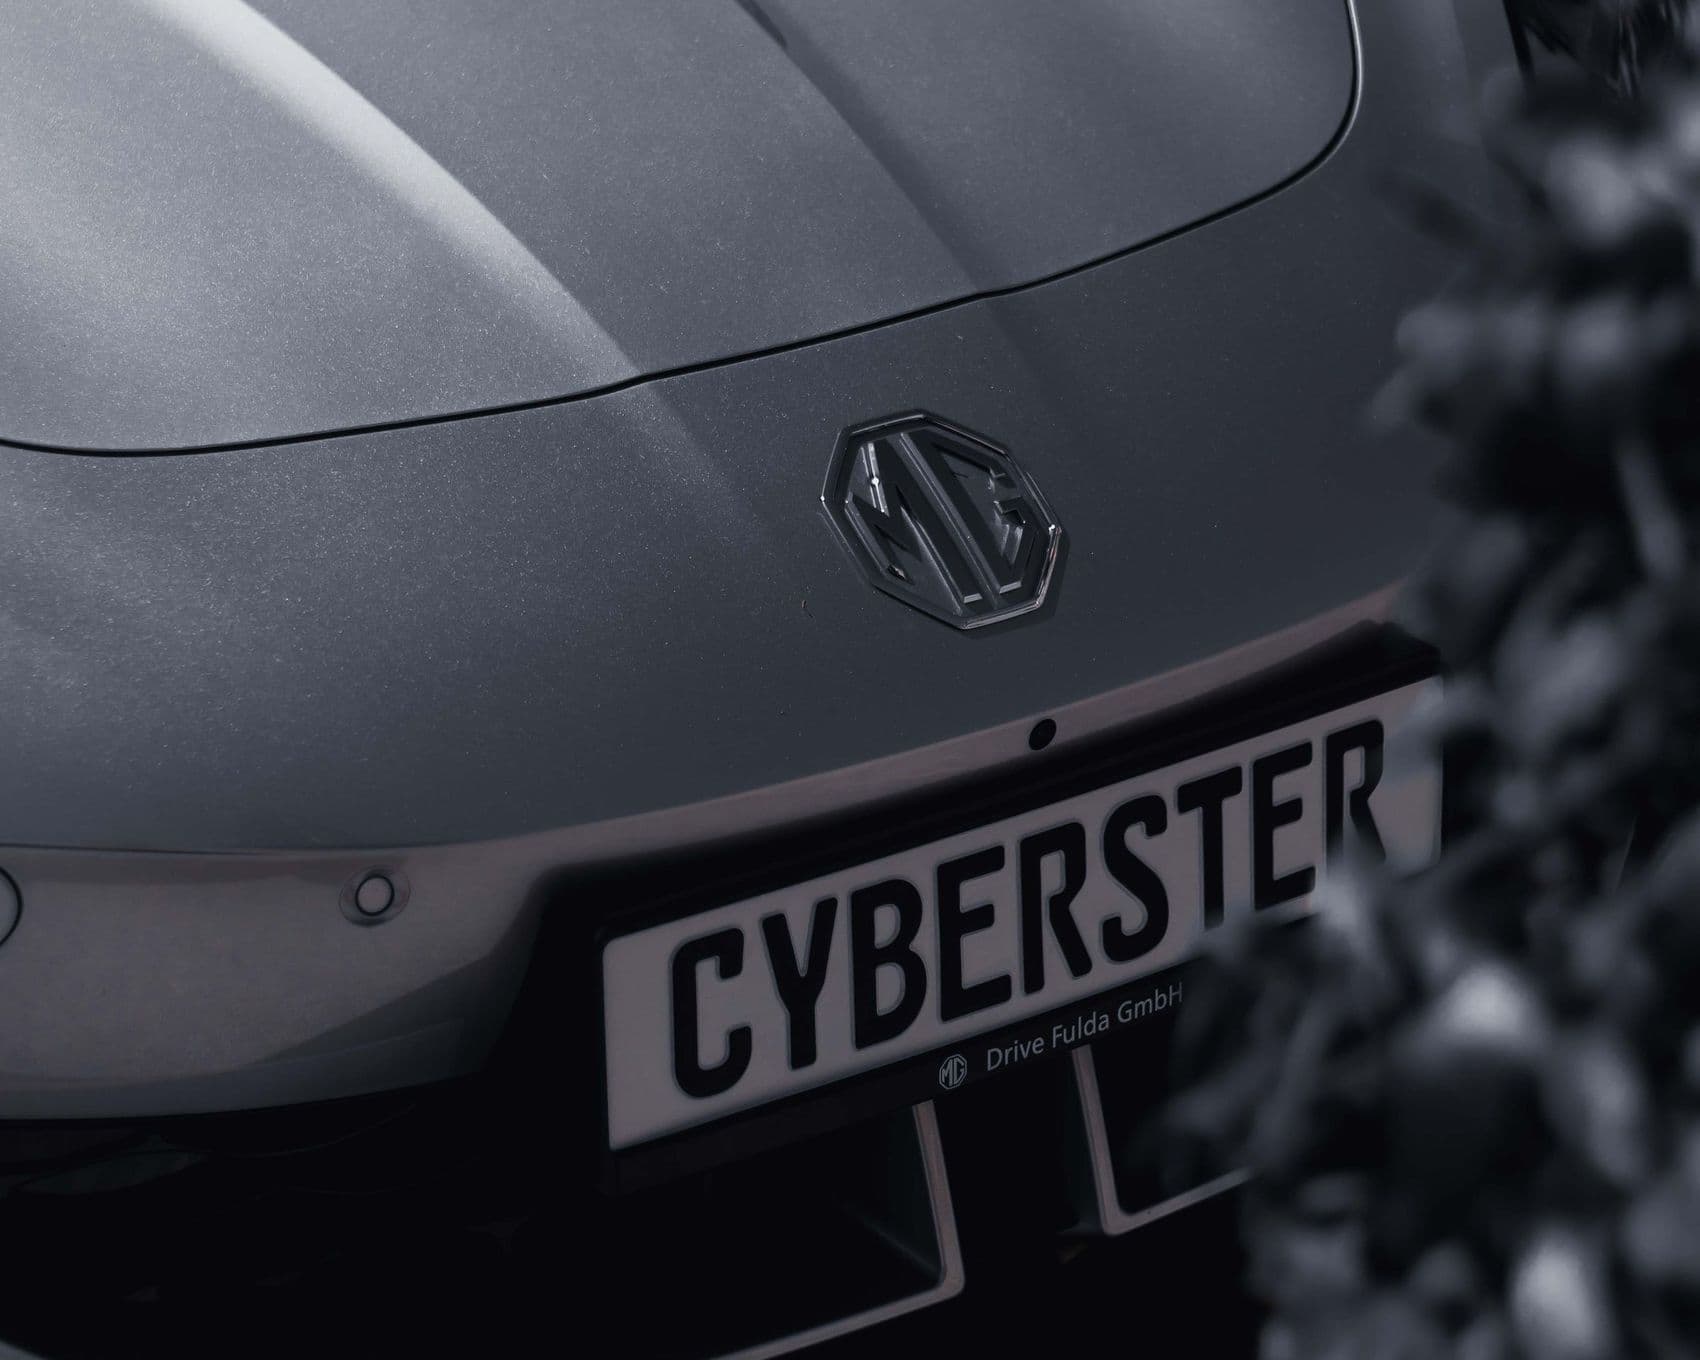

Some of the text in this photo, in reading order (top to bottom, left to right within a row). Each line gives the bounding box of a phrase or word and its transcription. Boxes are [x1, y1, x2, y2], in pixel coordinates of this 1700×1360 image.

[843, 428, 1042, 615] MG
[671, 719, 1387, 1098] CYBERSTER
[939, 981, 1183, 1088] MG Drive Fulda GmbH
